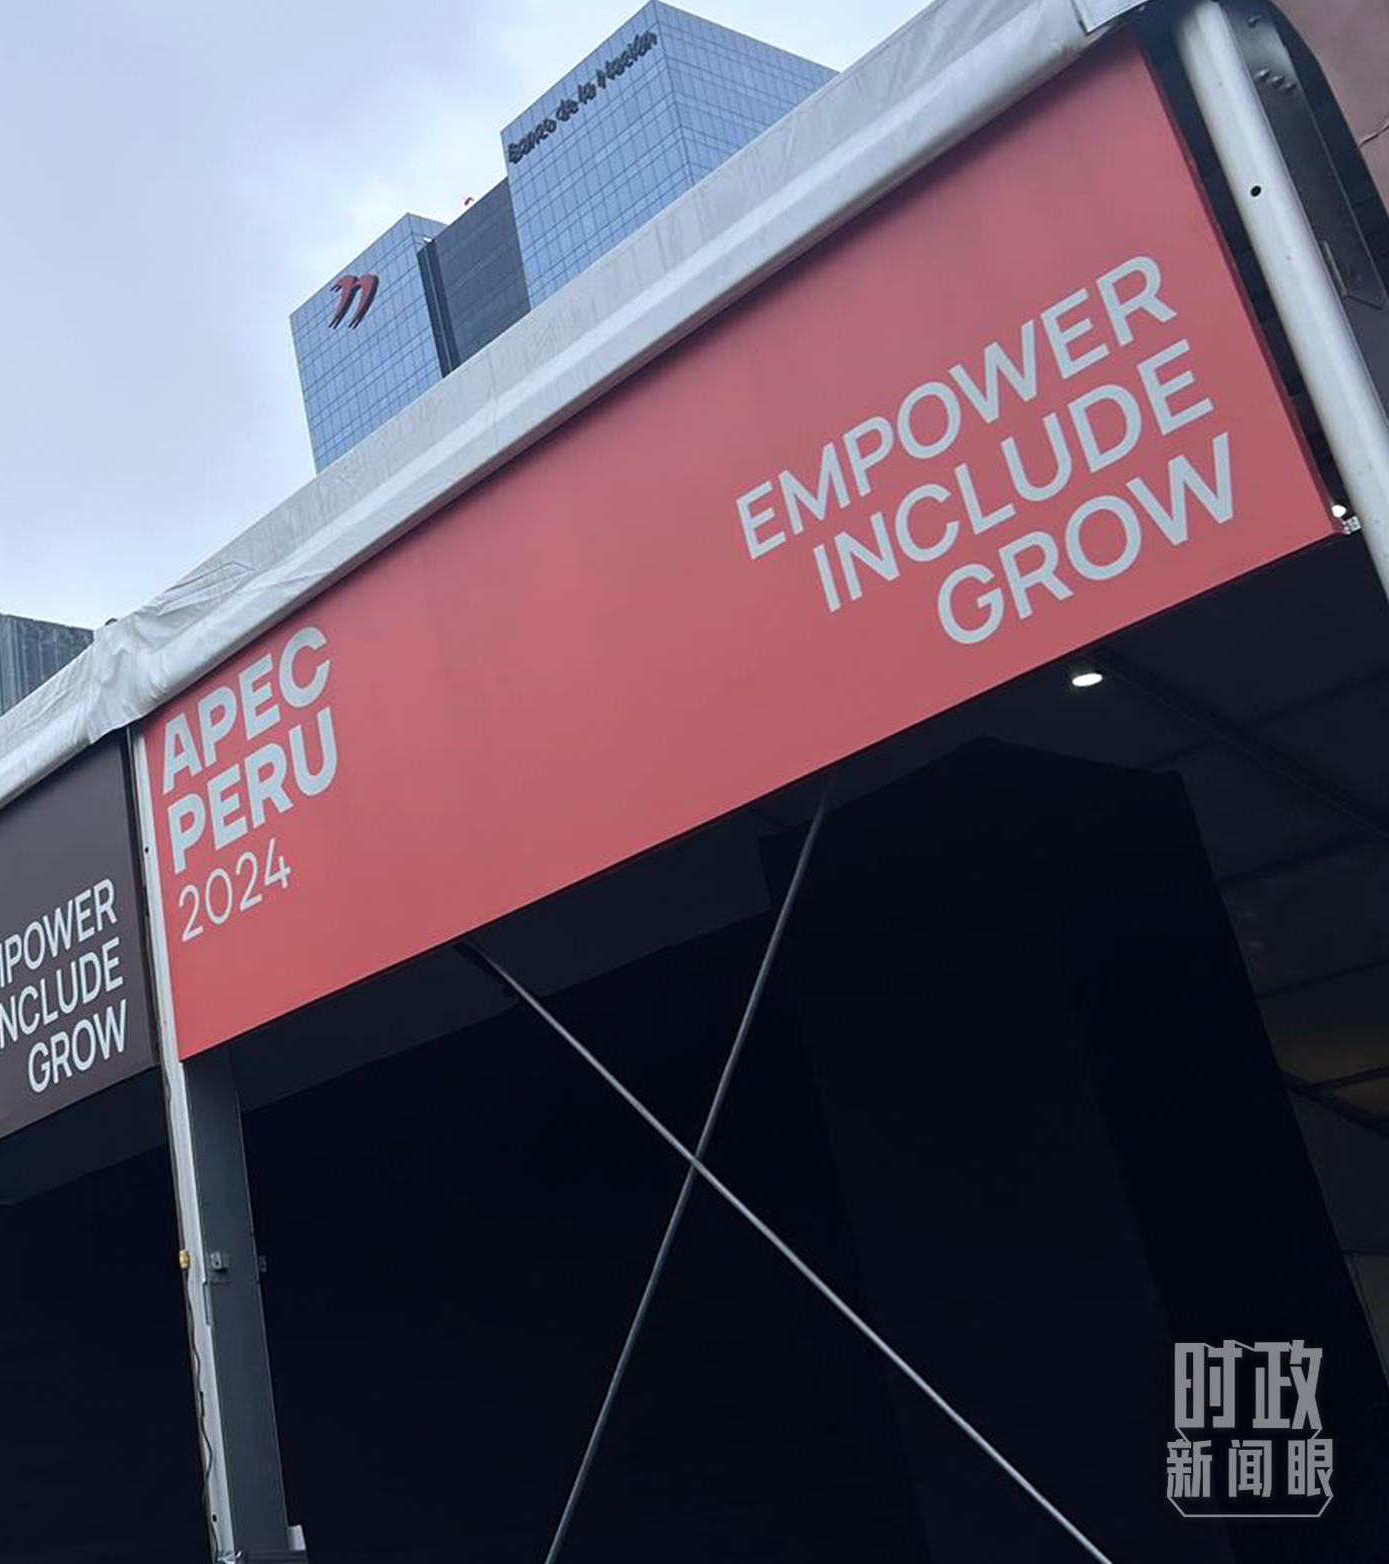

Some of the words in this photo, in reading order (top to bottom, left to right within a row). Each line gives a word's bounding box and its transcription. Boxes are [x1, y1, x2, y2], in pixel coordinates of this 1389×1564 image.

[508, 117, 557, 164] Banco
[556, 99, 579, 122] de
[578, 82, 597, 105] la
[735, 255, 1177, 560] EMPOWER
[813, 338, 1214, 612] INCLUDE
[937, 432, 1234, 644] GROW
[163, 626, 331, 796] APEC
[167, 706, 338, 875] PERU
[179, 837, 292, 942] 2024
[28, 999, 127, 1094] GROW
